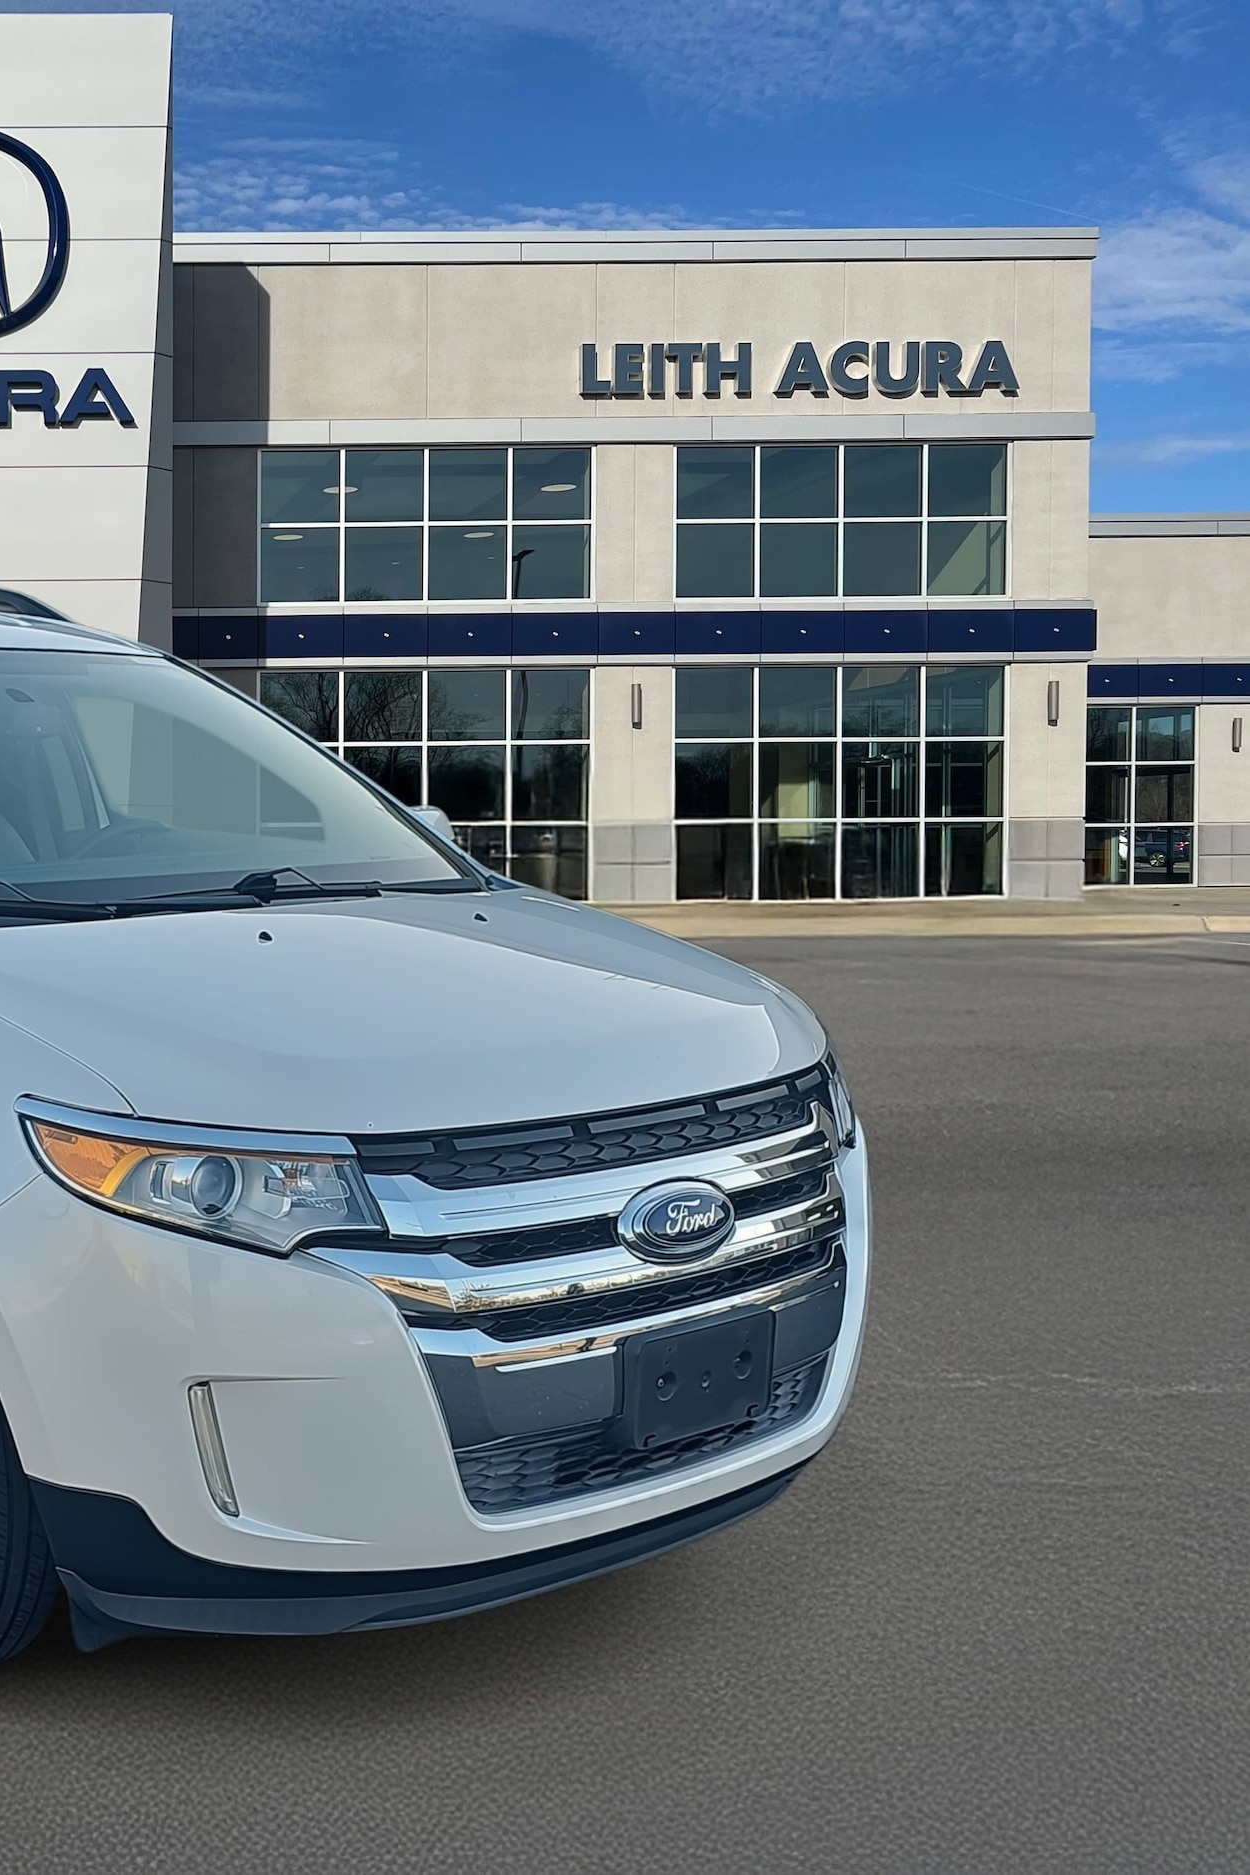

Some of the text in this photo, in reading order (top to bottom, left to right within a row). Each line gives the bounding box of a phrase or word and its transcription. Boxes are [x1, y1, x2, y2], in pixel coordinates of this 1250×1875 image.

[579, 340, 1019, 399] LEITH ACURA
[665, 1198, 717, 1237] Ford
